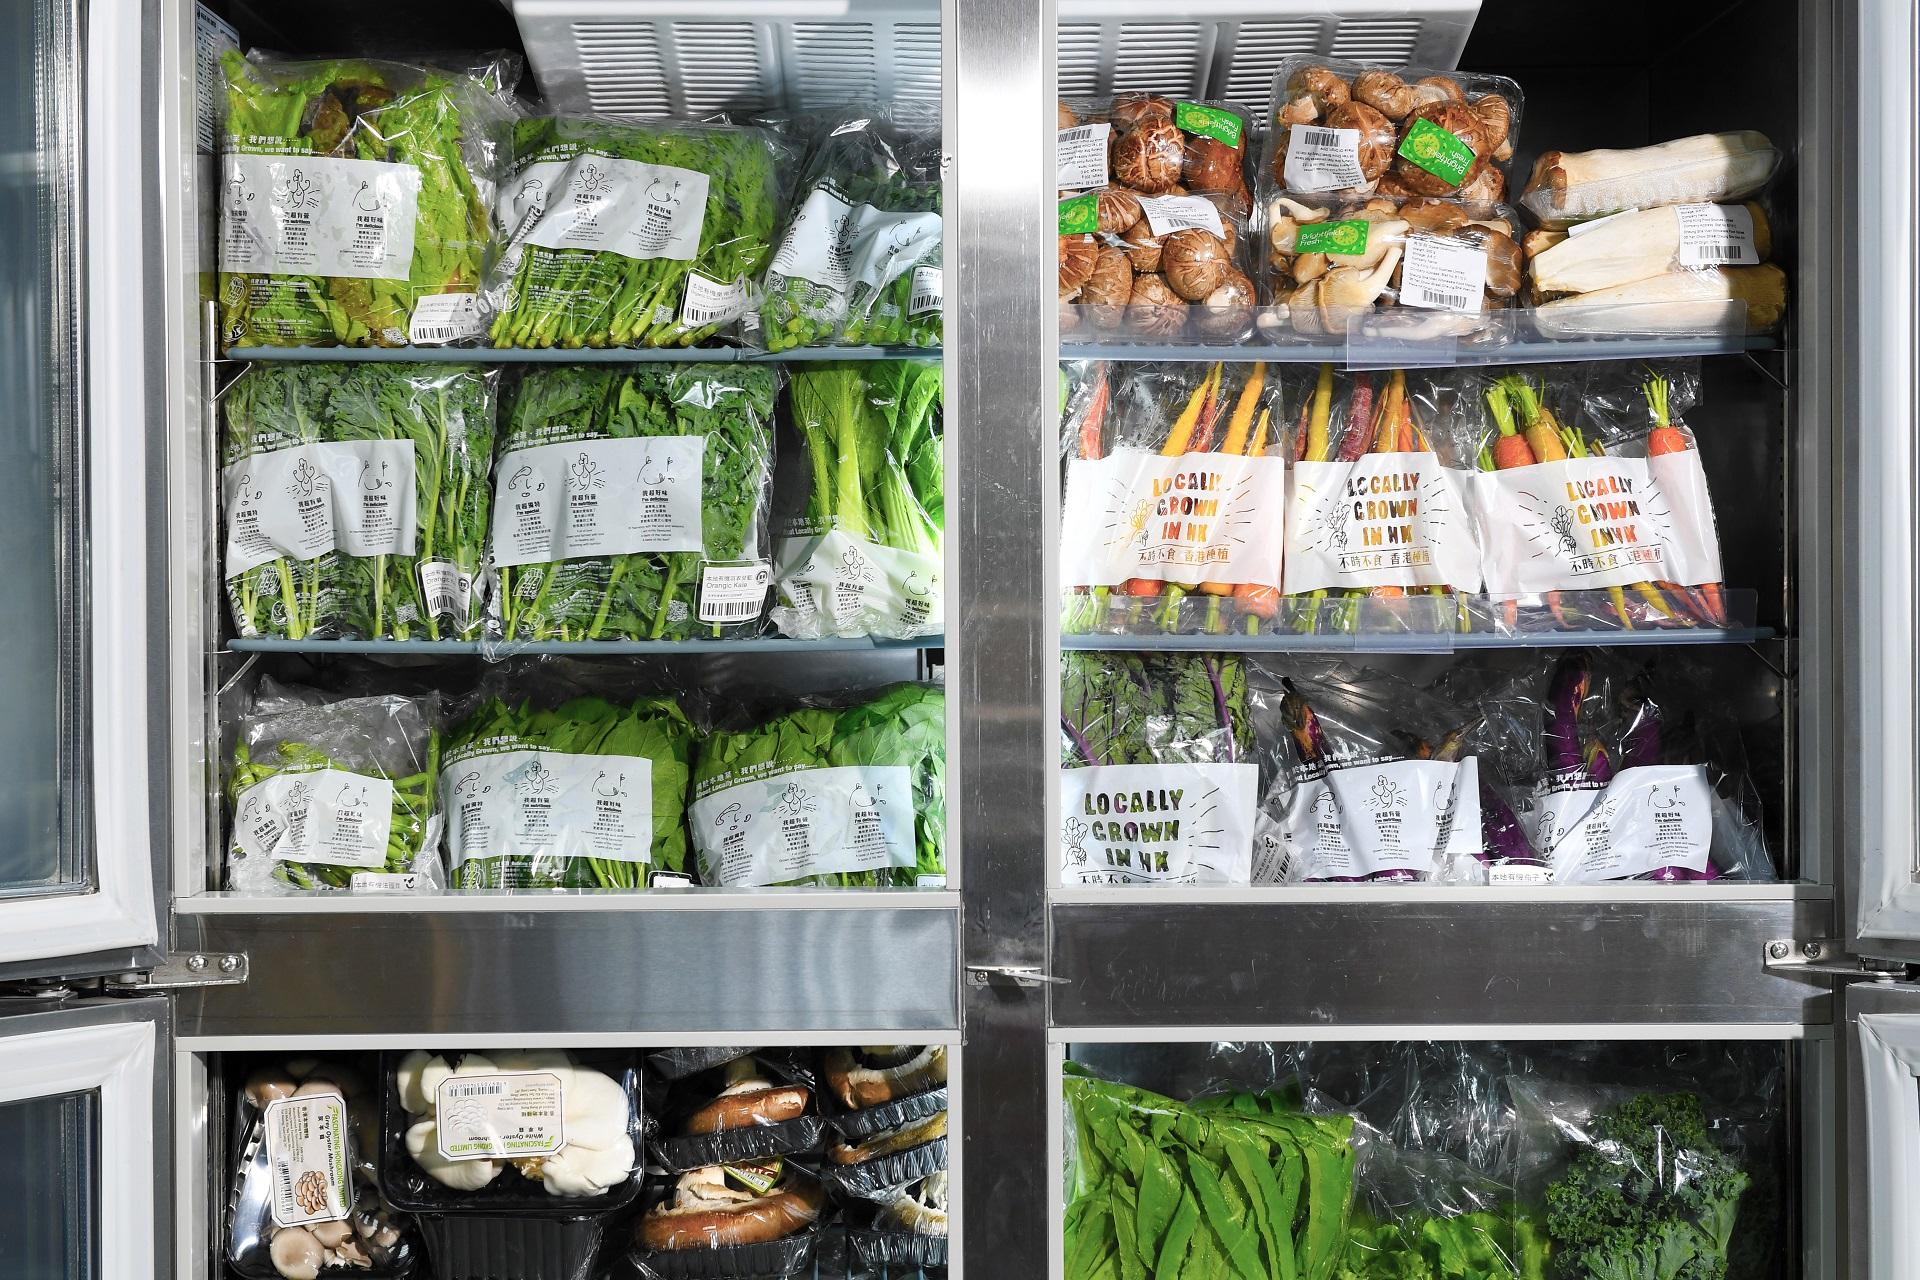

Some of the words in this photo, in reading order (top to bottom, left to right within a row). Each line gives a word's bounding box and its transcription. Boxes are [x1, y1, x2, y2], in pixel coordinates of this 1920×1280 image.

[1301, 228, 1344, 240] Brightfields
[1347, 472, 1420, 497] LOCALLY
[1157, 496, 1218, 517] GROWN
[1354, 498, 1418, 521] GROWN
[1162, 521, 1181, 540] IN
[1363, 526, 1382, 546] IN
[1388, 524, 1413, 544] HK
[1339, 554, 1382, 569] 不時不食
[1571, 553, 1618, 572] 不時不食
[1085, 789, 1184, 815] LOCALLY
[1092, 820, 1179, 843] GROWN
[1106, 848, 1131, 867] IN
[1138, 851, 1169, 873] HK
[450, 1144, 472, 1152] LIMITED
[506, 1141, 544, 1149] FASCINATING
[331, 1114, 340, 1151] FASCINATING
[338, 1185, 347, 1208] LIMITED
